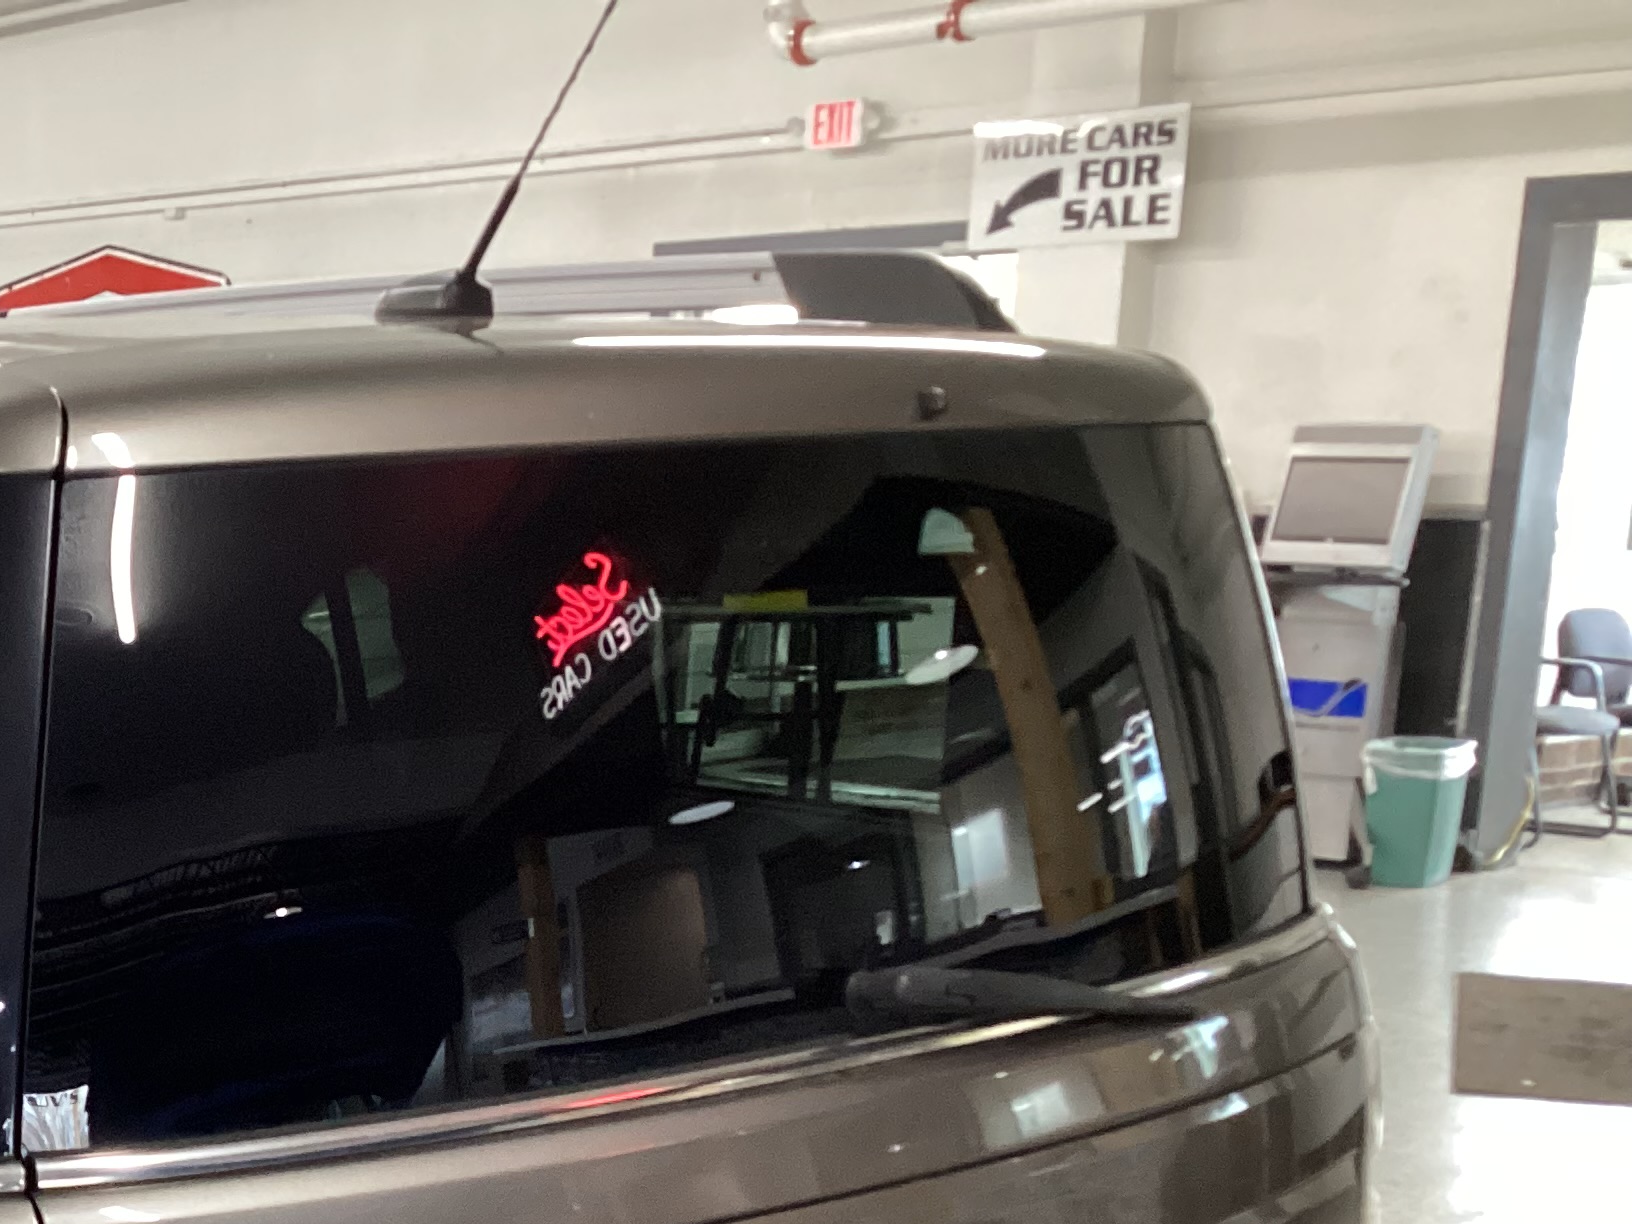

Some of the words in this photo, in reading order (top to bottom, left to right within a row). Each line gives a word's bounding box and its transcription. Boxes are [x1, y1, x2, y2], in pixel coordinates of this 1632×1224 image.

[812, 99, 857, 146] EXIT
[1085, 118, 1179, 152] CARS
[1077, 152, 1162, 192] FOR
[1060, 192, 1172, 232] SALE
